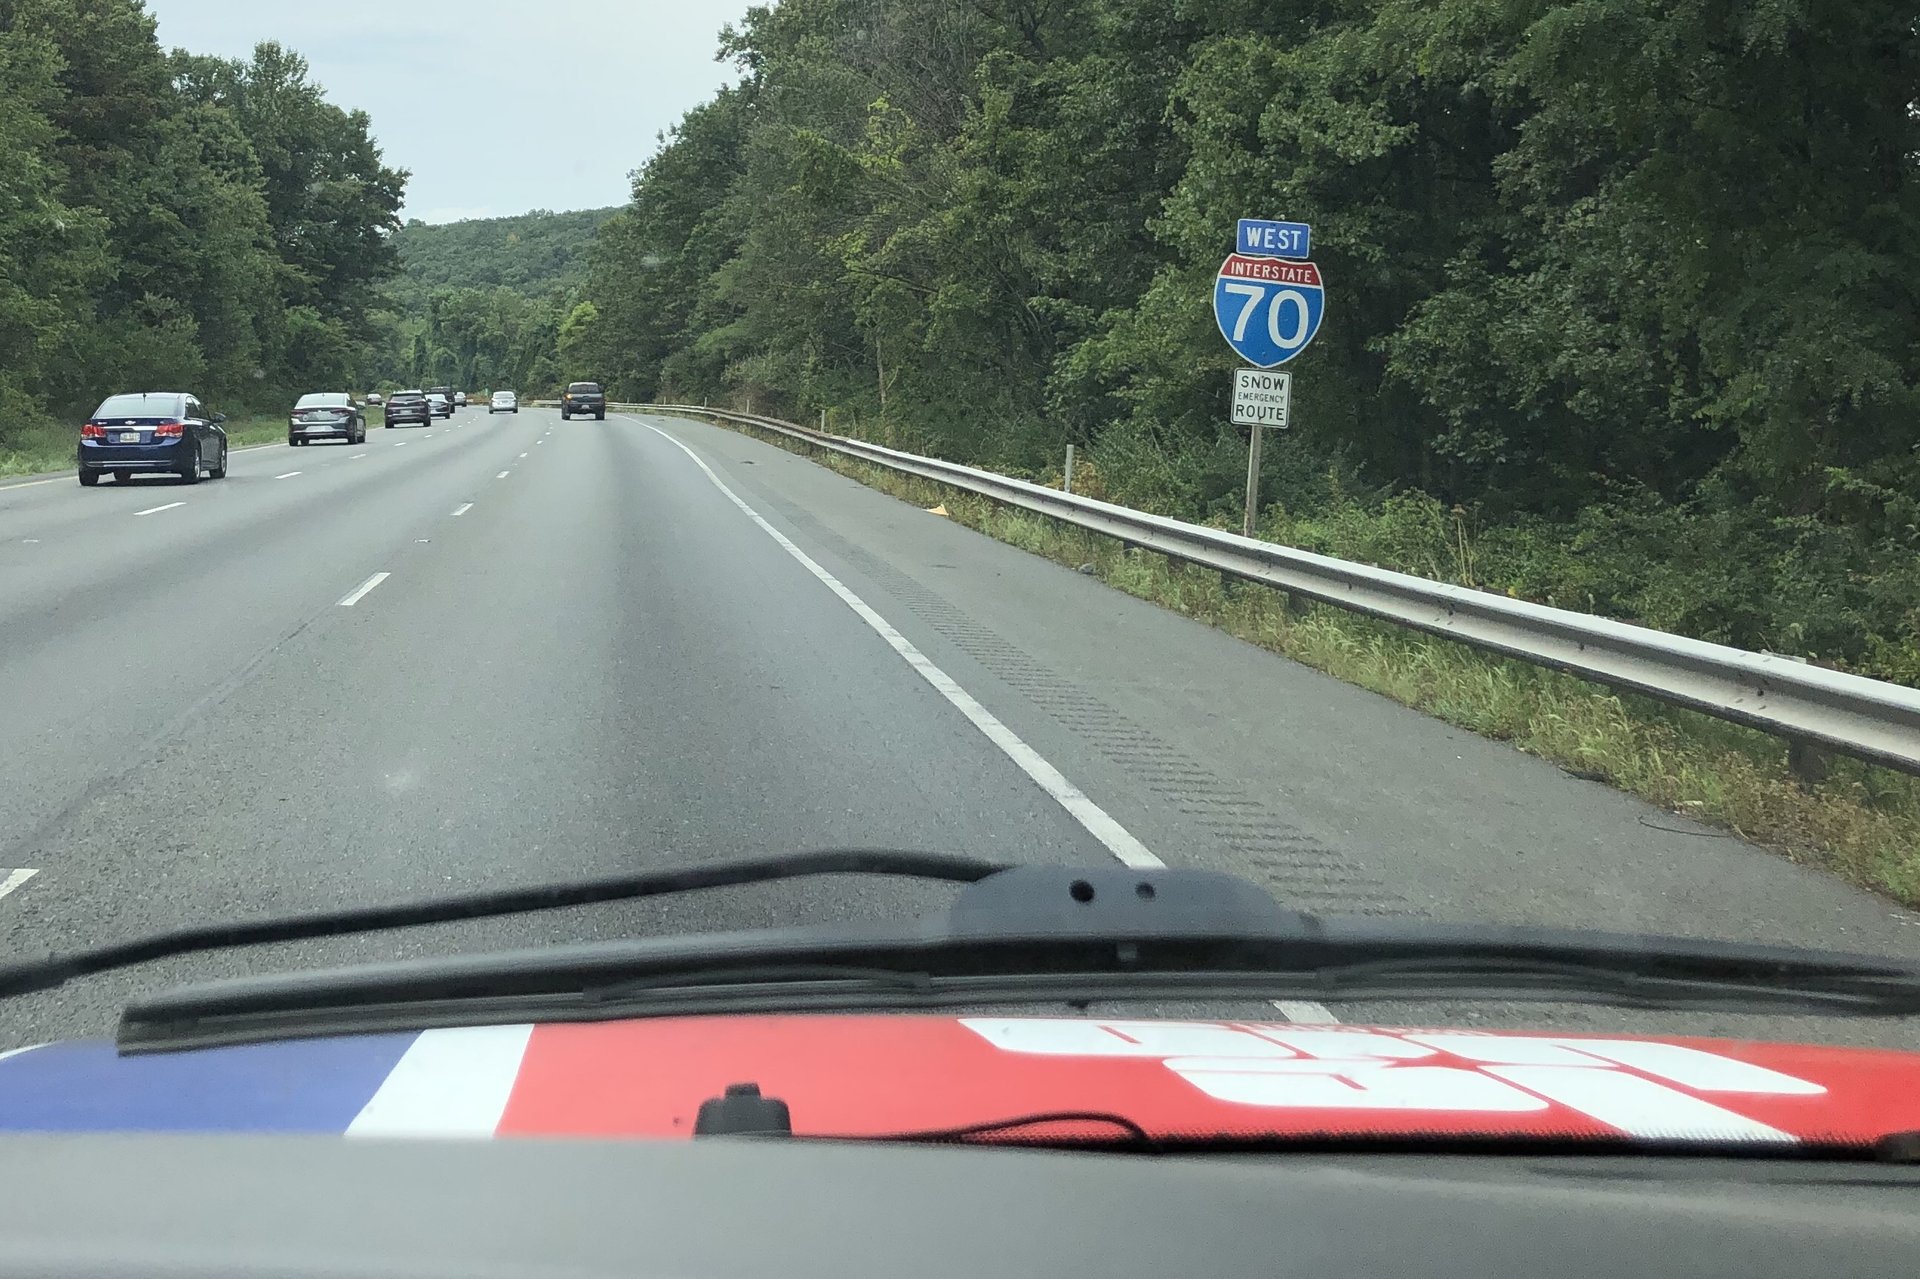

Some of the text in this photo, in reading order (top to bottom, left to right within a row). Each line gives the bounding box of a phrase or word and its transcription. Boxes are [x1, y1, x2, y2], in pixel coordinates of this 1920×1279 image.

[1246, 226, 1302, 250] WEST
[1230, 262, 1312, 282] INTERSTATE
[1225, 283, 1309, 349] 70
[1240, 375, 1285, 391] SNOW
[1238, 391, 1284, 404] EMERGENCY
[1235, 404, 1285, 421] ROUTE
